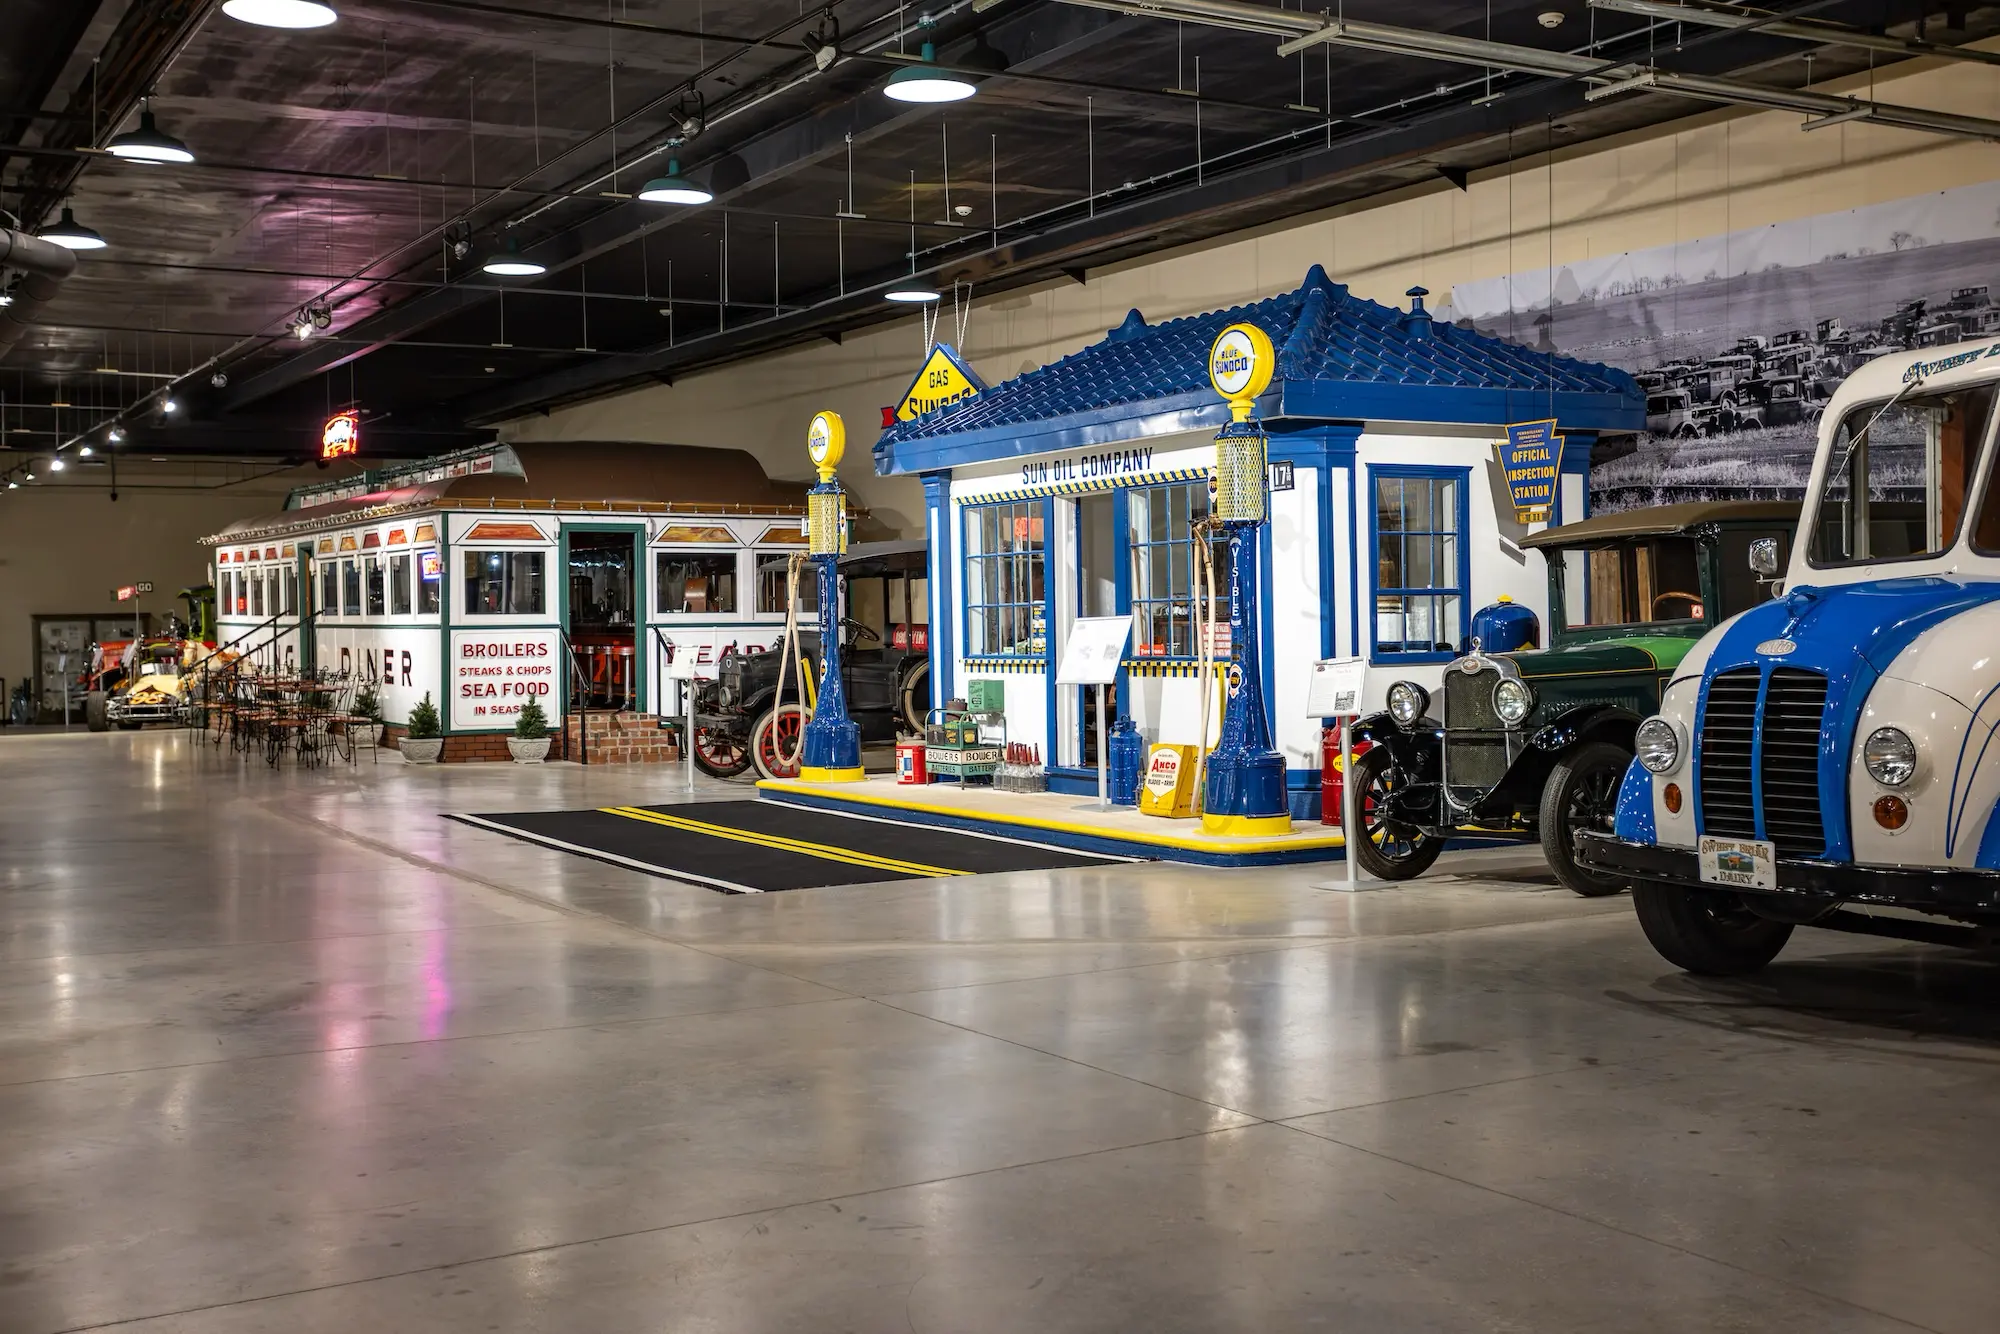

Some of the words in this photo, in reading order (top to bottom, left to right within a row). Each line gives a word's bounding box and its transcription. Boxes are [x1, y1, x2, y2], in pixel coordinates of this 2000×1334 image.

[1221, 349, 1238, 359] BLUE
[1216, 356, 1248, 375] SUNOCO
[929, 369, 949, 388] GAS
[1512, 447, 1551, 464] OFFICIAL
[1022, 461, 1048, 485] SUN
[1054, 458, 1076, 481] OIL
[1081, 446, 1153, 478] COMPANY
[1275, 466, 1286, 486] 17
[1507, 466, 1555, 482] INSPECTION
[1514, 484, 1549, 499] STATION
[138, 583, 152, 592] GO
[1231, 547, 1240, 616] VISIBLE
[462, 643, 549, 658] BROILERS
[224, 641, 294, 674] ADING
[341, 647, 412, 688] DINER
[460, 667, 502, 676] STEAKS
[507, 666, 514, 675] &
[517, 666, 552, 675] CHOPS
[462, 684, 497, 697] SEA
[503, 682, 549, 696] FOOD
[475, 706, 486, 715] IN
[491, 705, 520, 714] SEAS
[928, 751, 959, 762] BOWERS
[966, 751, 998, 762] BOWER
[931, 764, 956, 774] BATTERIES
[968, 764, 997, 774] BATTERIE
[1151, 758, 1176, 773] ANCO
[1701, 839, 1735, 854] SWEET
[1719, 871, 1755, 885] DAIRY
